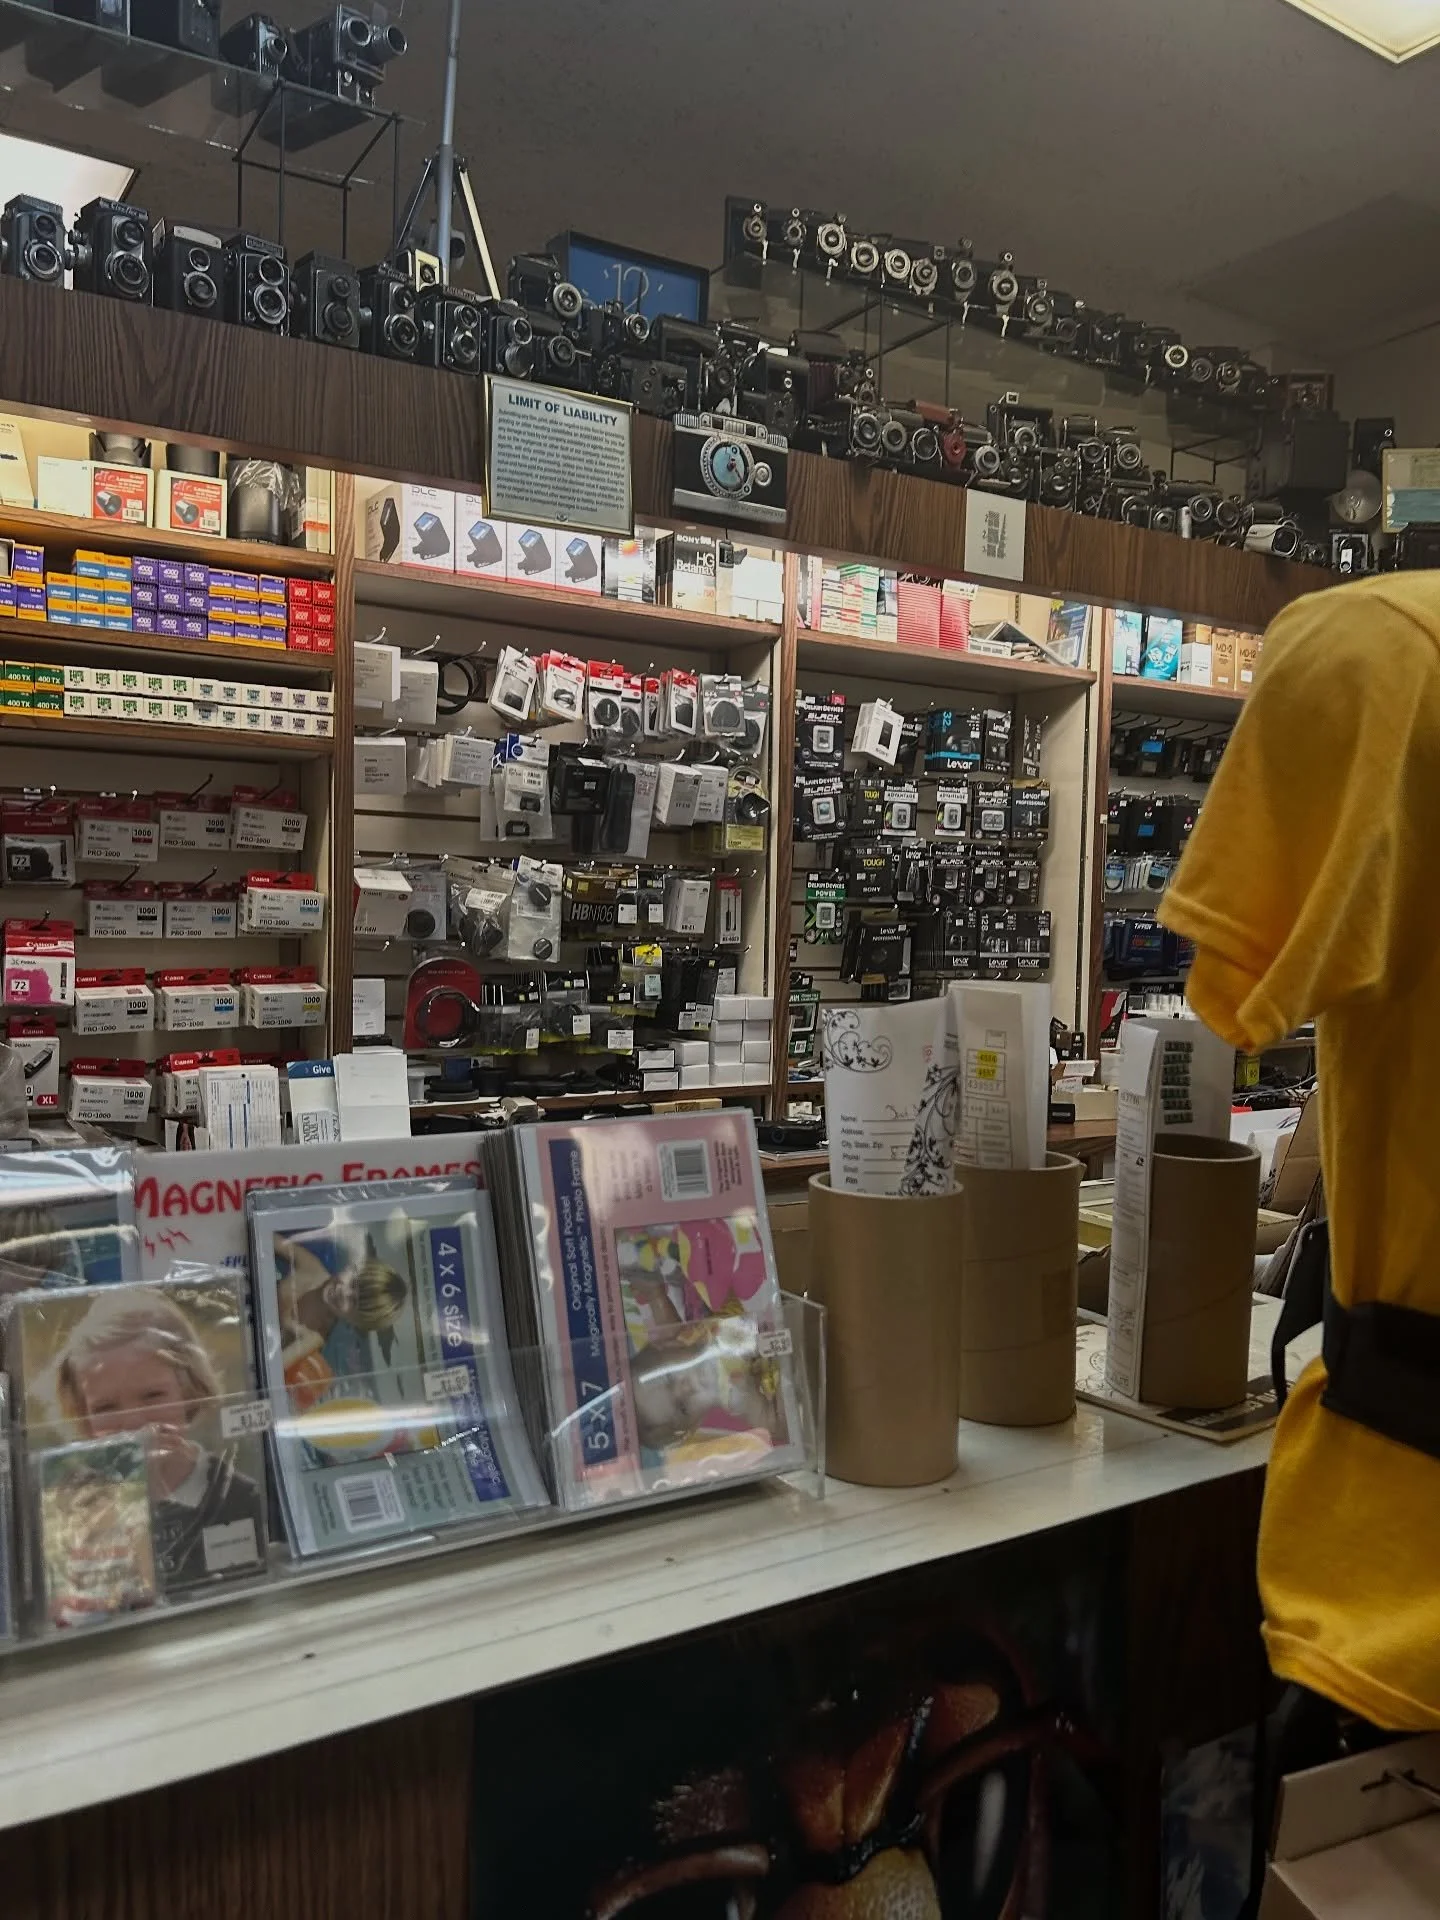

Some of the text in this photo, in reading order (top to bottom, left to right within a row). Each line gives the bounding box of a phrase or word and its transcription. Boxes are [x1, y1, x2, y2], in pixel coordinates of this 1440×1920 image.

[508, 393, 618, 426] LIMIT OF LIABILITY
[411, 486, 437, 497] DLC
[696, 552, 715, 567] HG
[676, 559, 715, 577] Betamax
[947, 758, 973, 769] Lexar
[864, 791, 880, 799] TOUGH
[284, 818, 300, 826] 1000
[134, 828, 151, 837] 1000
[15, 857, 27, 865] 72
[863, 858, 885, 866] TOUGH
[980, 913, 989, 932] 128
[988, 957, 1008, 966] Lexar
[1017, 957, 1040, 966] Lexar
[15, 981, 26, 989] 72
[129, 1000, 146, 1008] 1000
[304, 996, 320, 1004] 1000
[312, 1064, 331, 1074] Give
[126, 1090, 143, 1098] 1000
[42, 1095, 55, 1105] XL
[437, 1242, 457, 1256] 4
[438, 1263, 455, 1277] x
[441, 1283, 461, 1298] 6
[444, 1303, 464, 1347] size
[588, 1428, 609, 1450] 5
